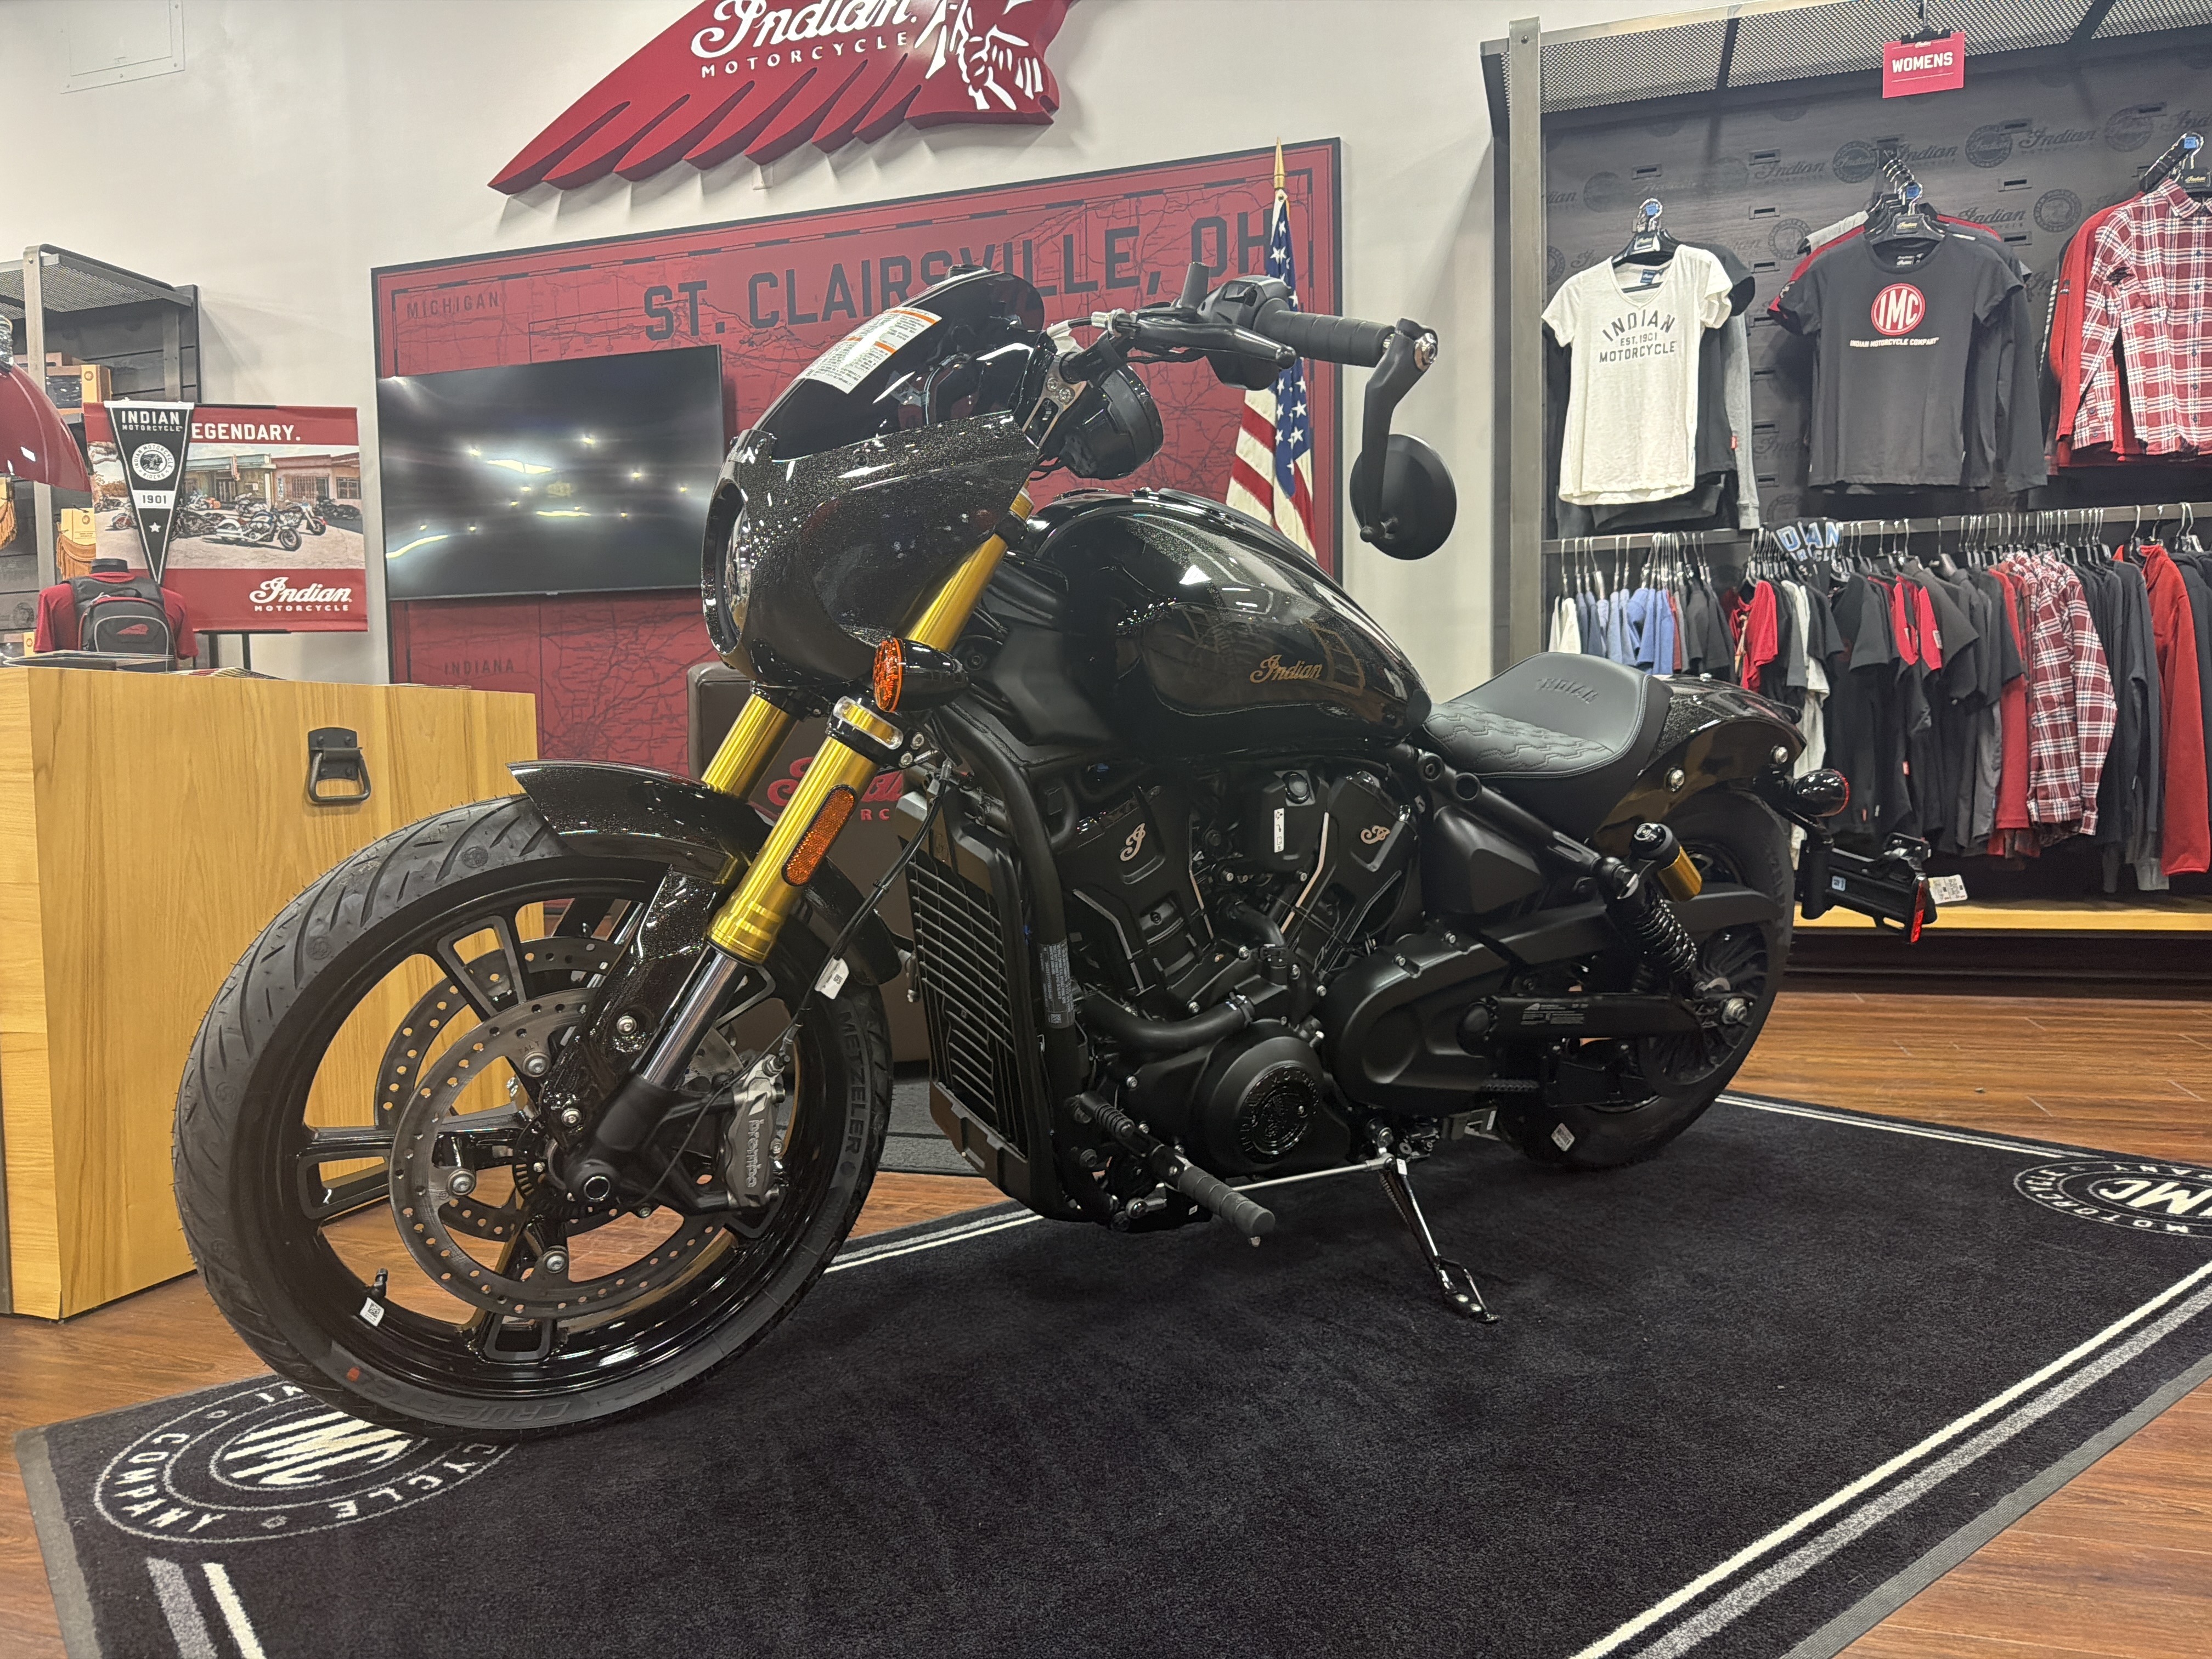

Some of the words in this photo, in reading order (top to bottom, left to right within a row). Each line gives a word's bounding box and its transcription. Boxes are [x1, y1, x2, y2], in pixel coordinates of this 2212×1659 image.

[702, 31, 909, 78] MOTORCYCLE
[1892, 52, 1953, 73] WOMENS
[644, 279, 725, 342] ST.
[1189, 207, 1275, 278] OH
[407, 291, 499, 319] MICHIGAN
[1878, 289, 1918, 330] IMC
[1602, 309, 1675, 342] INDIAN
[1599, 341, 1677, 363] MOTORCYCLE
[121, 410, 180, 425] INDIAN
[191, 422, 301, 441] EGENDARY.
[133, 449, 143, 469] INDIAN
[143, 444, 173, 469] MOTORCYCLE
[142, 494, 167, 504] 1901
[444, 658, 514, 676] INDIANA
[1250, 654, 1323, 683] Indian
[839, 1011, 866, 1154] METZELER
[746, 1118, 765, 1188] brembo
[2025, 1169, 2190, 1234] MOTORCYCLE
[114, 1432, 227, 1533] COMPANY
